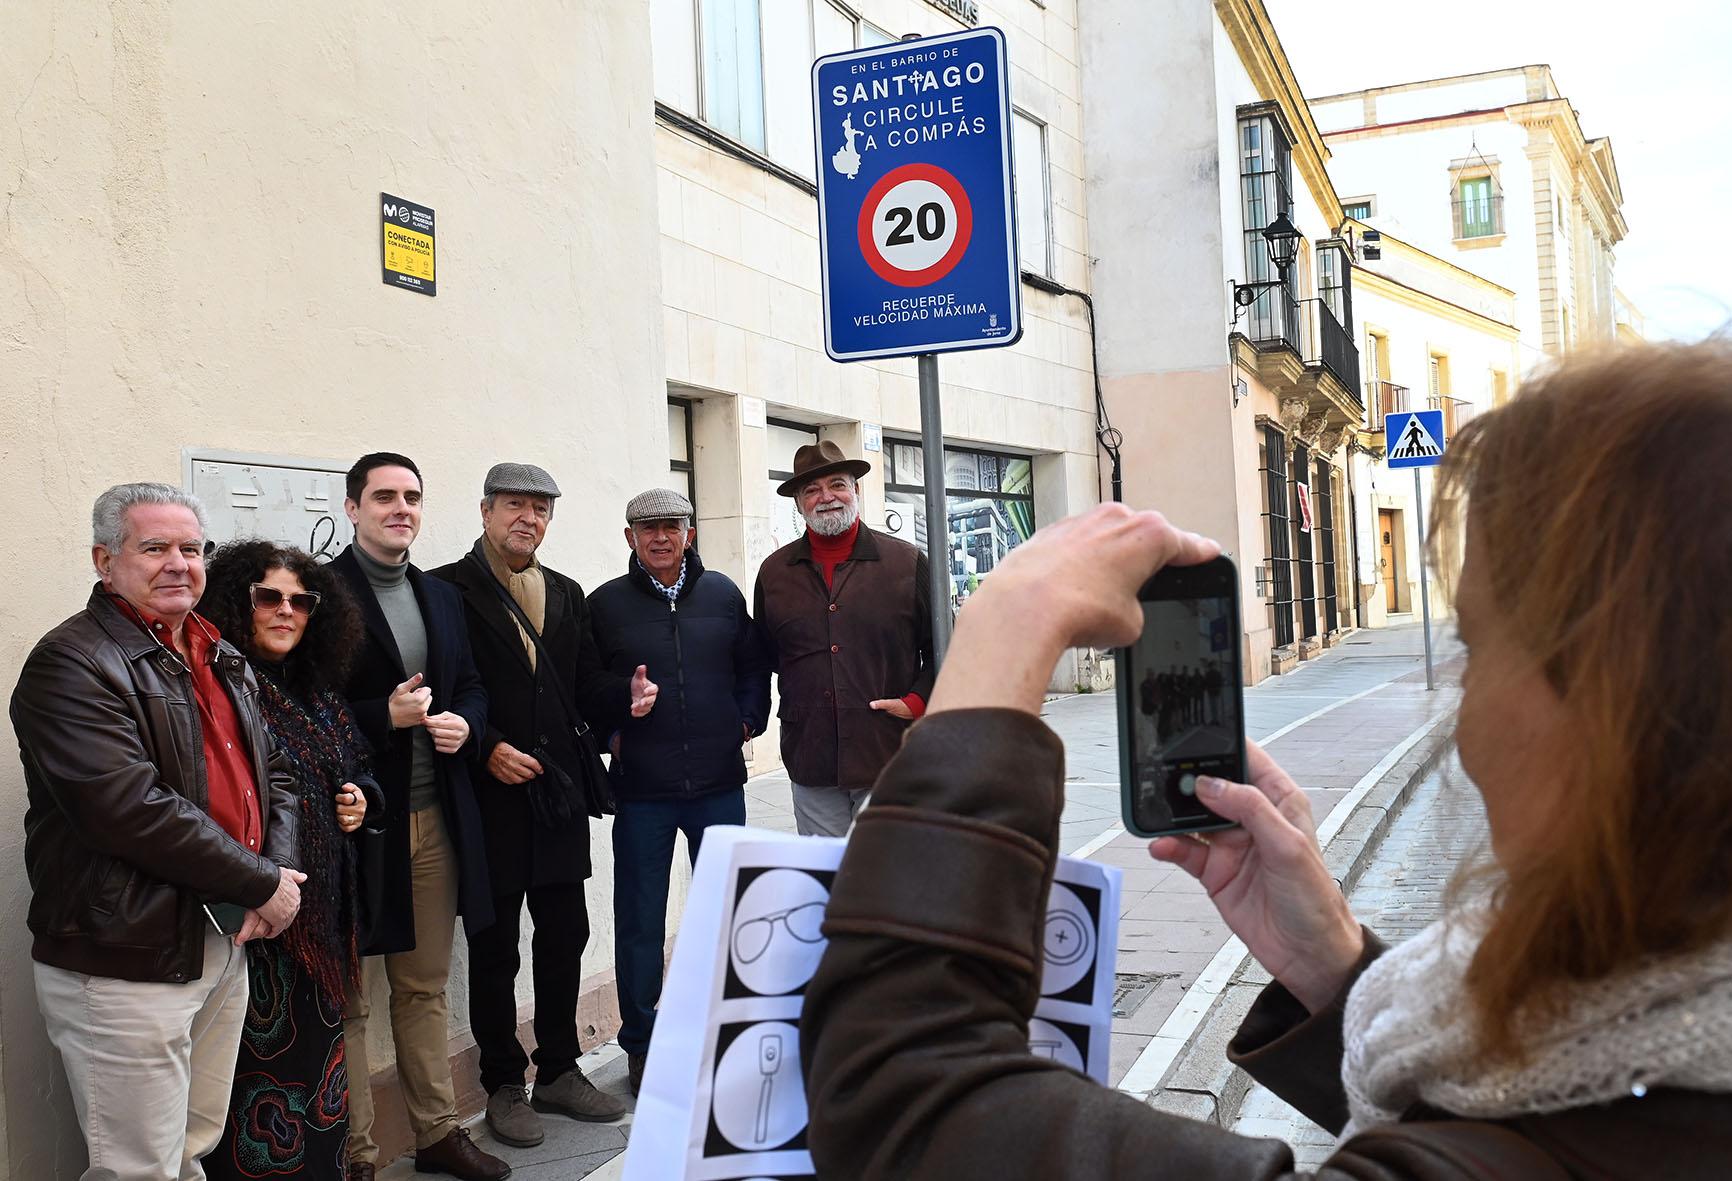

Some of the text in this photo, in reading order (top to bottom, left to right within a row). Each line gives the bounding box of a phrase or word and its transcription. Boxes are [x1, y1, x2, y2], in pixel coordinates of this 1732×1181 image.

[851, 48, 959, 74] EN EL BARRIO DE
[863, 96, 964, 127] CIRCULE
[865, 116, 985, 151] A COMPÁS
[884, 202, 946, 247] 20
[387, 230, 431, 250] CONECTADA
[853, 303, 987, 326] VELOCIDAD MÁXIMA
[882, 294, 955, 311] RECUERDE
